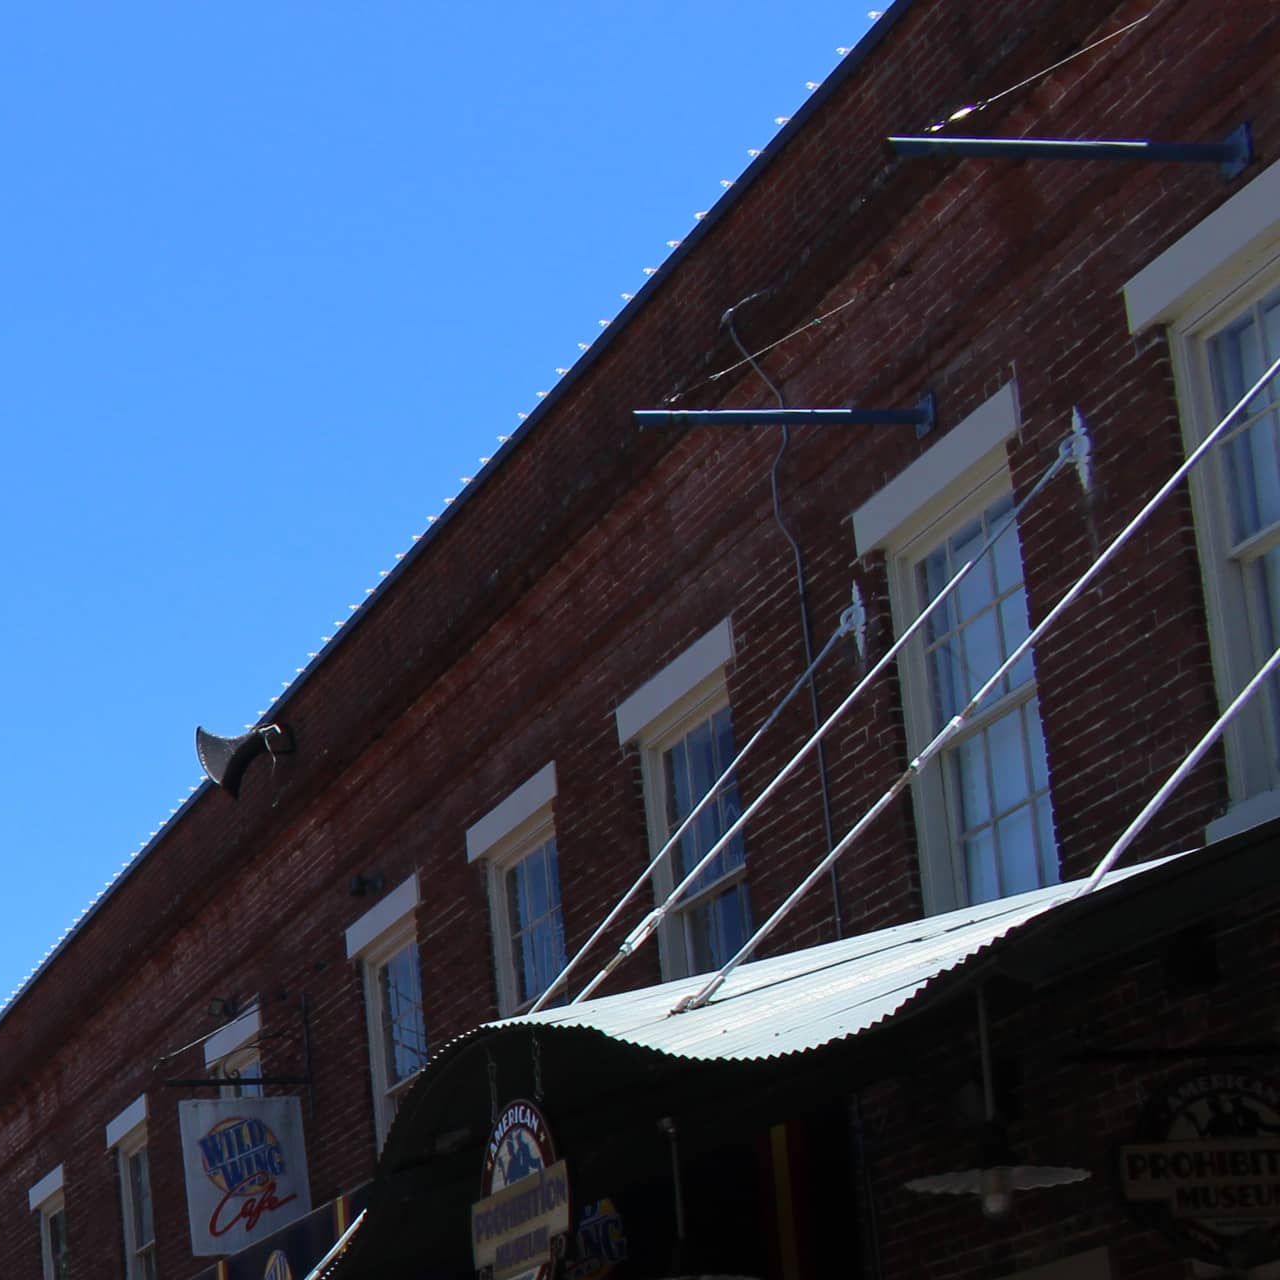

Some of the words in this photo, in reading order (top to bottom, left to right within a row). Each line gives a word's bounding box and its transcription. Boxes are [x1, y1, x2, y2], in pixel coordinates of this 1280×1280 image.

[199, 1119, 266, 1170] WILD
[490, 1105, 539, 1160] AMERICAN
[221, 1147, 285, 1191] WING
[474, 1176, 568, 1244] PROHIBITION
[495, 1225, 549, 1270] MUSEUM
